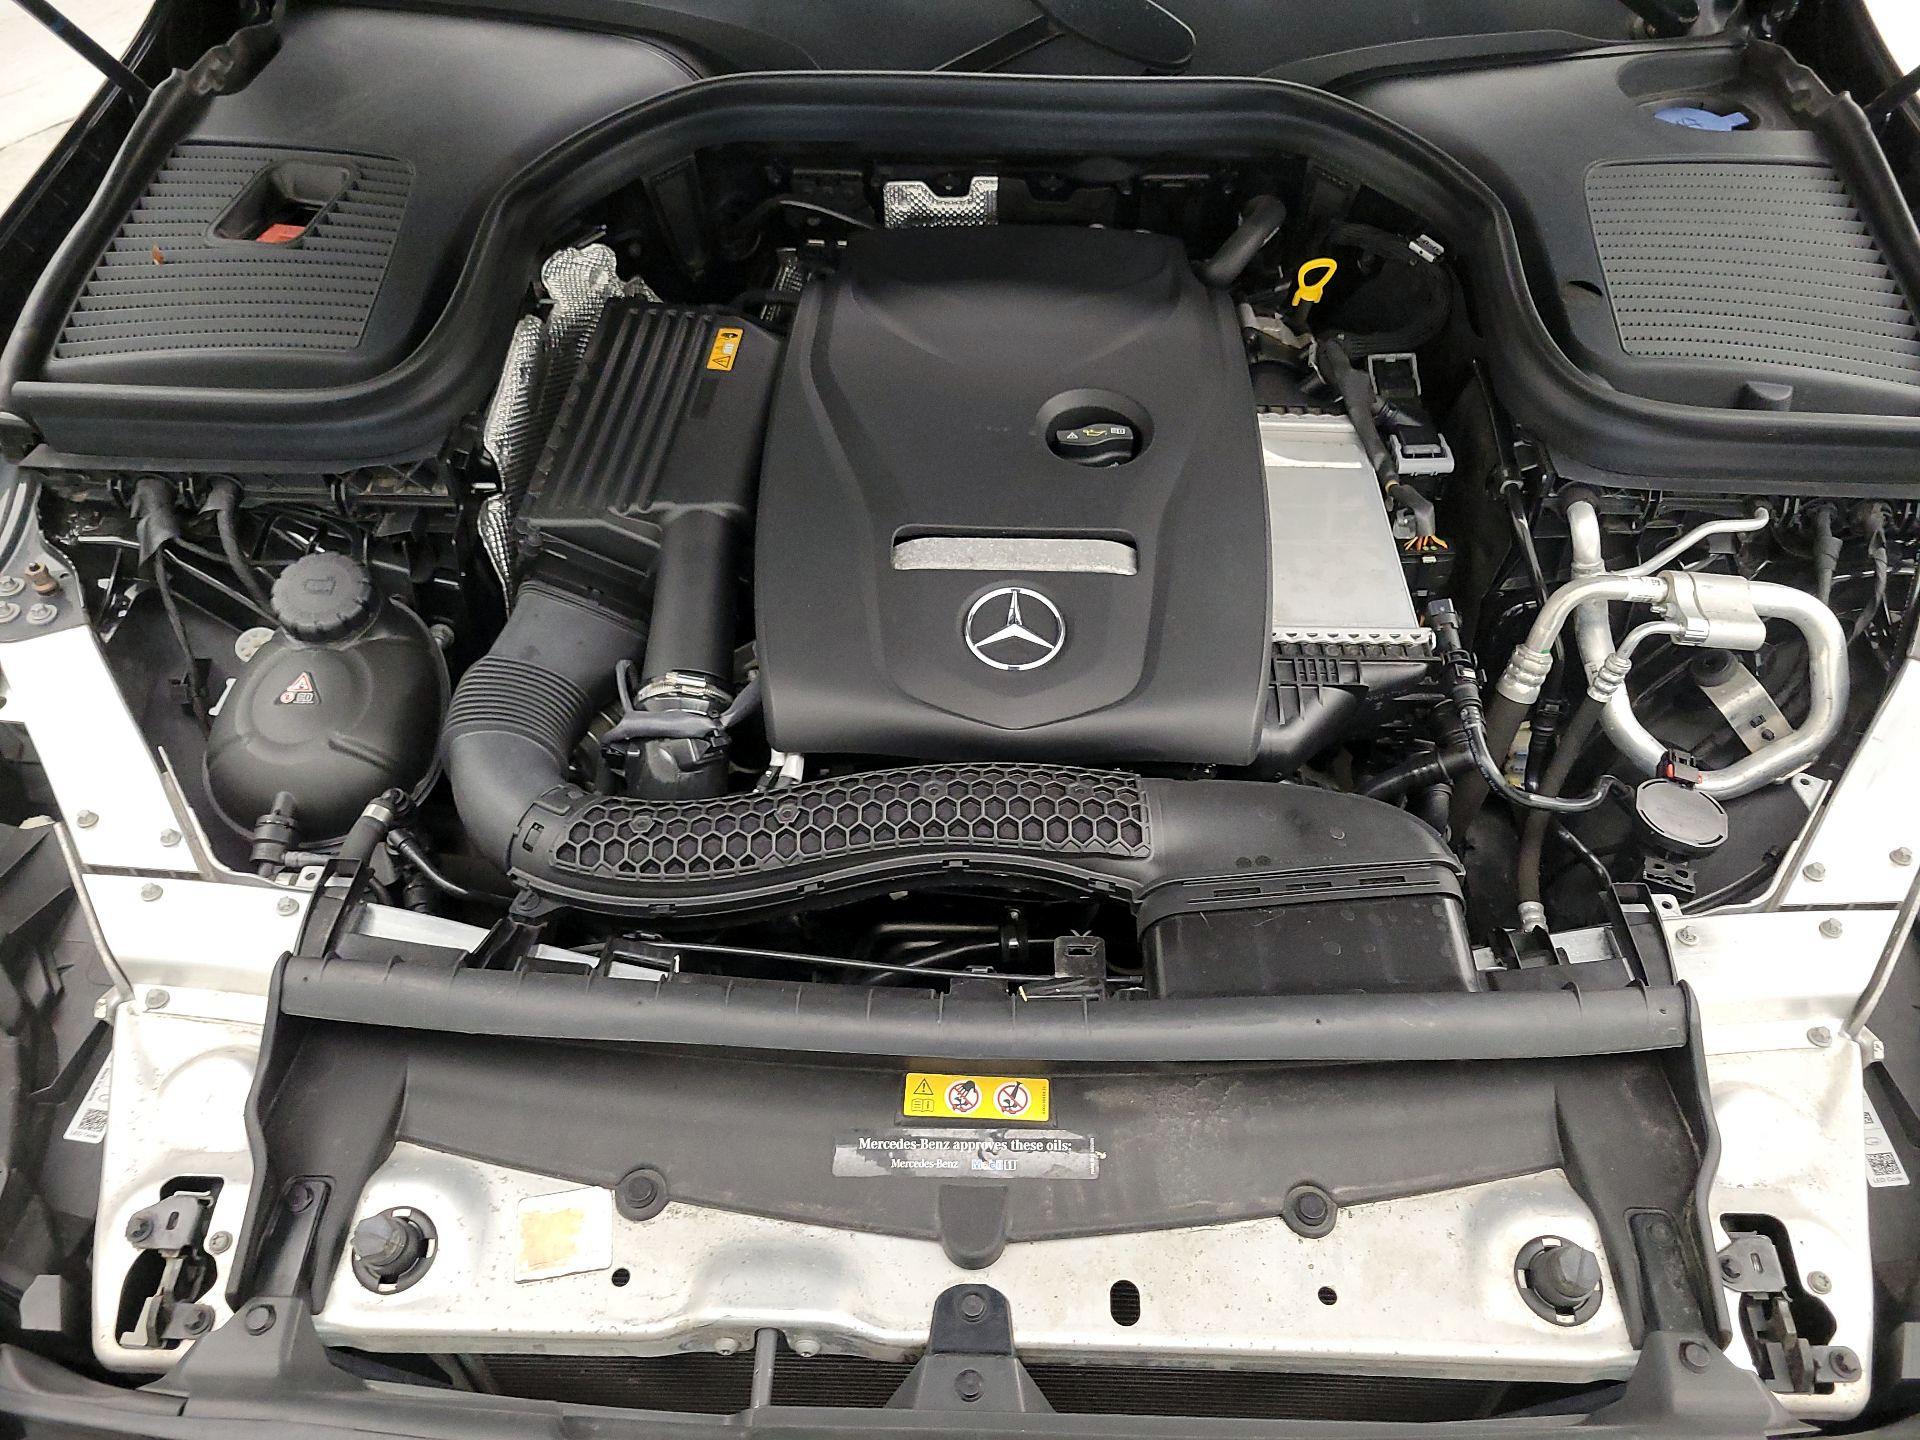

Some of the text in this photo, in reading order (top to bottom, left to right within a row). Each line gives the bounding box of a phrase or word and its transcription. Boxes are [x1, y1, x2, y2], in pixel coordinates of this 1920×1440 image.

[859, 1137, 1072, 1153] Mercedes-Benz approves these oils:
[890, 1159, 959, 1169] Mercedes-Benz
